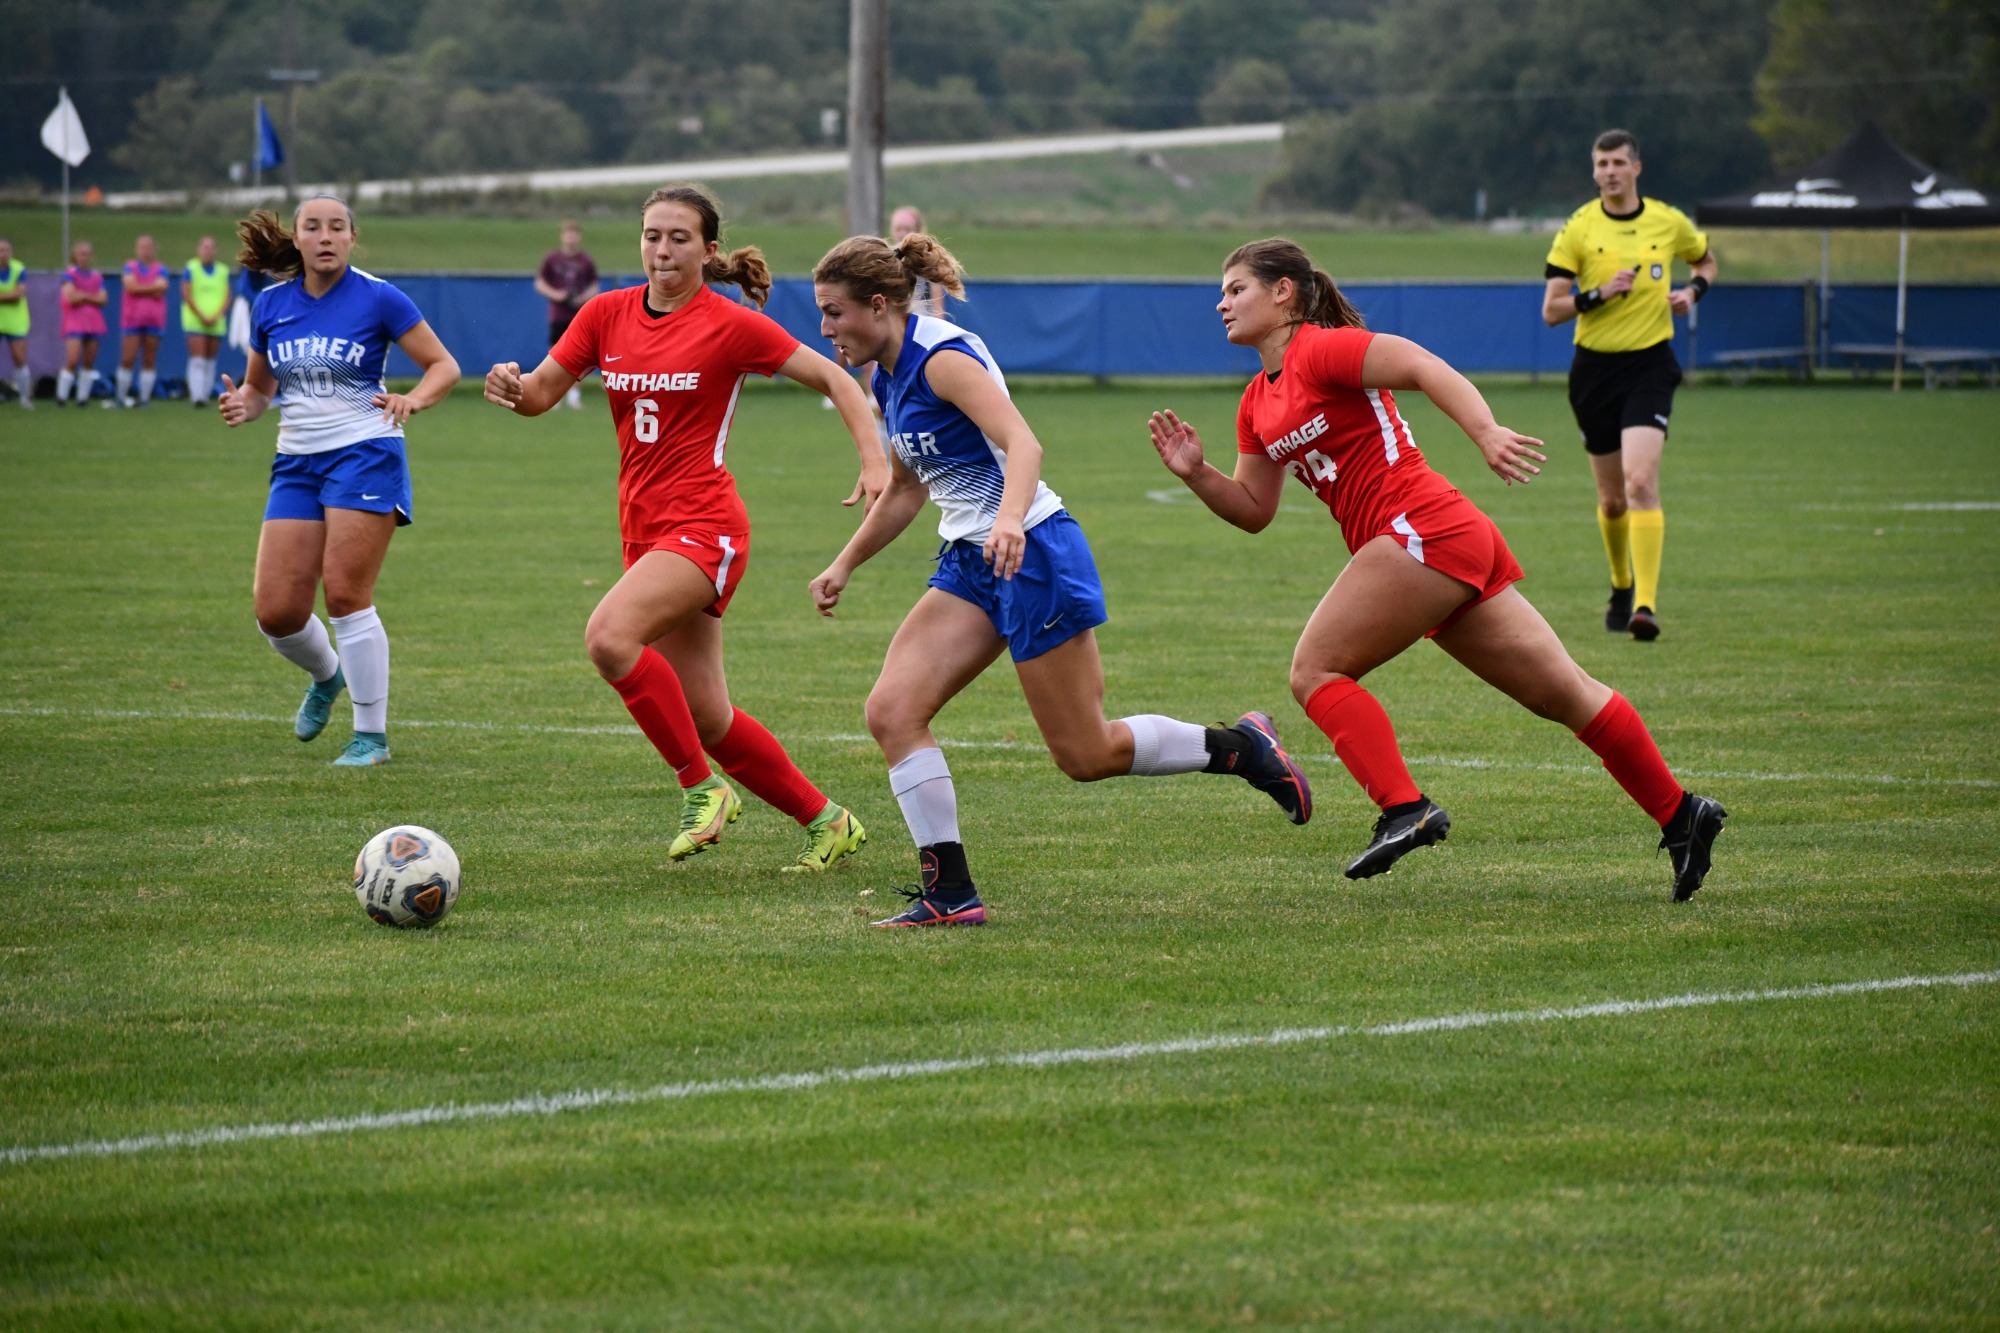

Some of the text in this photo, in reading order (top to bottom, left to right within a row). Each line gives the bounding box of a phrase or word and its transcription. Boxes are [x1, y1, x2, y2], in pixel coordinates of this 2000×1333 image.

[267, 337, 366, 368] LUTHER
[290, 365, 335, 398] 10
[634, 398, 660, 443] 6
